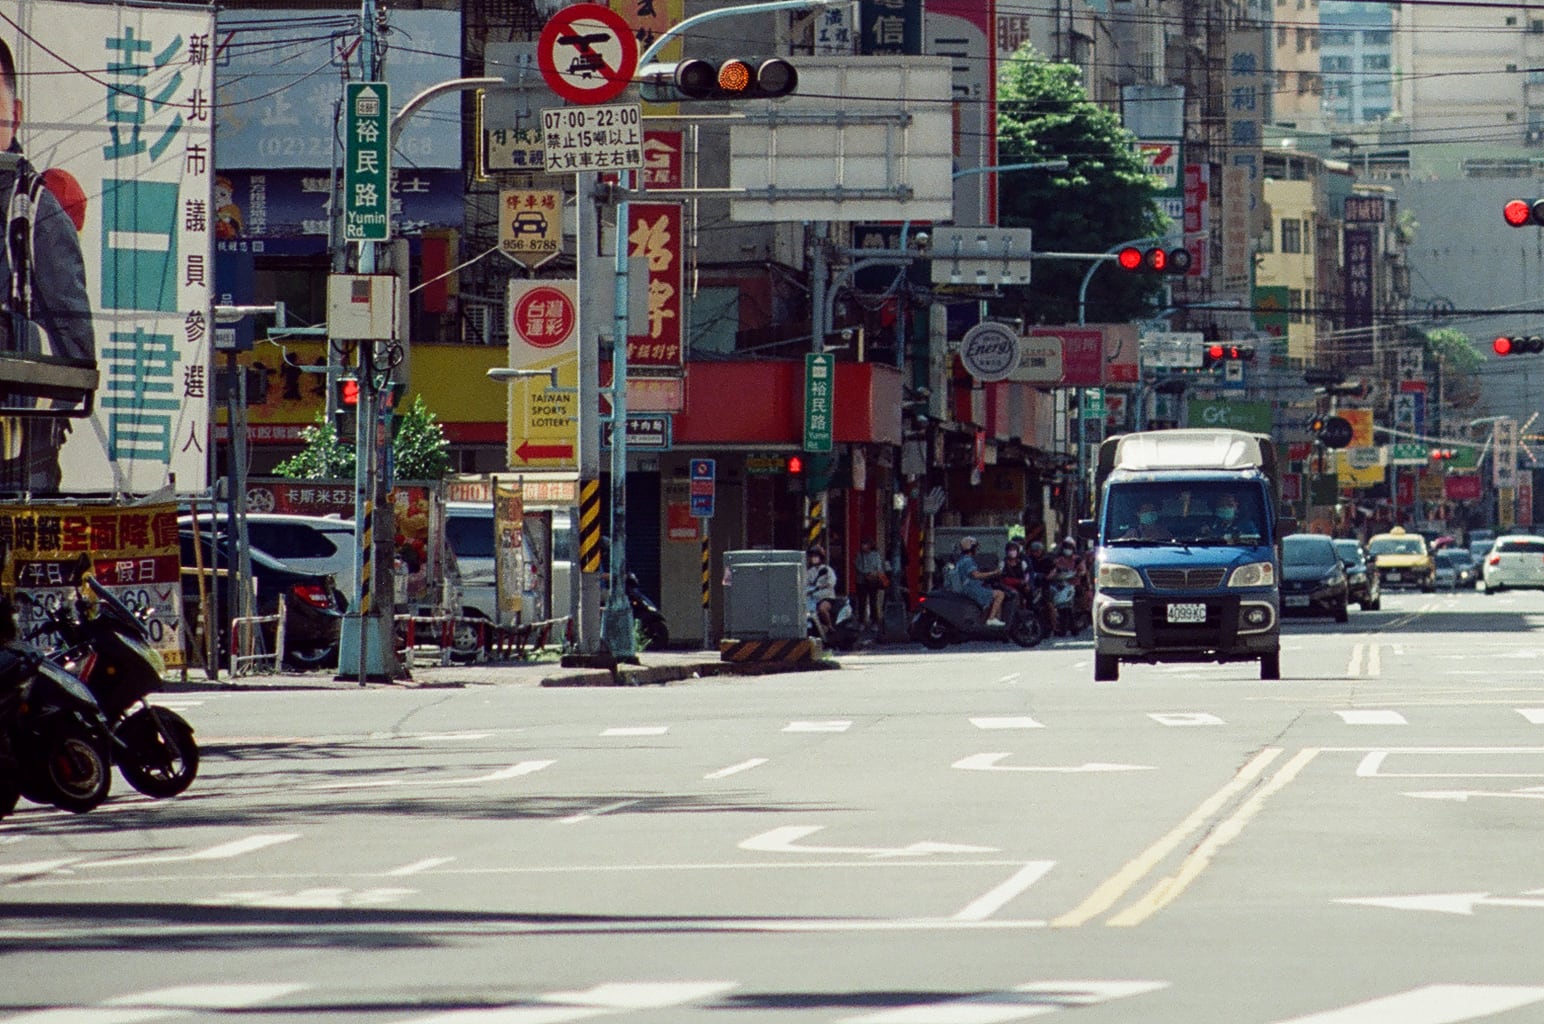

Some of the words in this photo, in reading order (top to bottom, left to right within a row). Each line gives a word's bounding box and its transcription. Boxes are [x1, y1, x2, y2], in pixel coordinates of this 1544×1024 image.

[544, 109, 638, 129] 07:00-22:00
[547, 129, 640, 148] 禁止15噸以上
[355, 119, 380, 207] 裕民路
[548, 151, 641, 168] 大貨車左右轉
[506, 194, 556, 210] 停車場
[348, 211, 386, 224] Yumin
[347, 224, 366, 237] Rd.
[100, 25, 186, 464] 彭一書
[182, 32, 210, 453] 新北市議員參選人
[527, 300, 563, 317] 台灣
[526, 318, 563, 336] 運彩
[966, 339, 1016, 358] Energy
[532, 393, 570, 404] TAIWAN
[811, 381, 827, 430] 裕民路
[532, 406, 567, 416] SPORTS
[532, 418, 570, 427] LOTTERY
[115, 559, 155, 582] 假日
